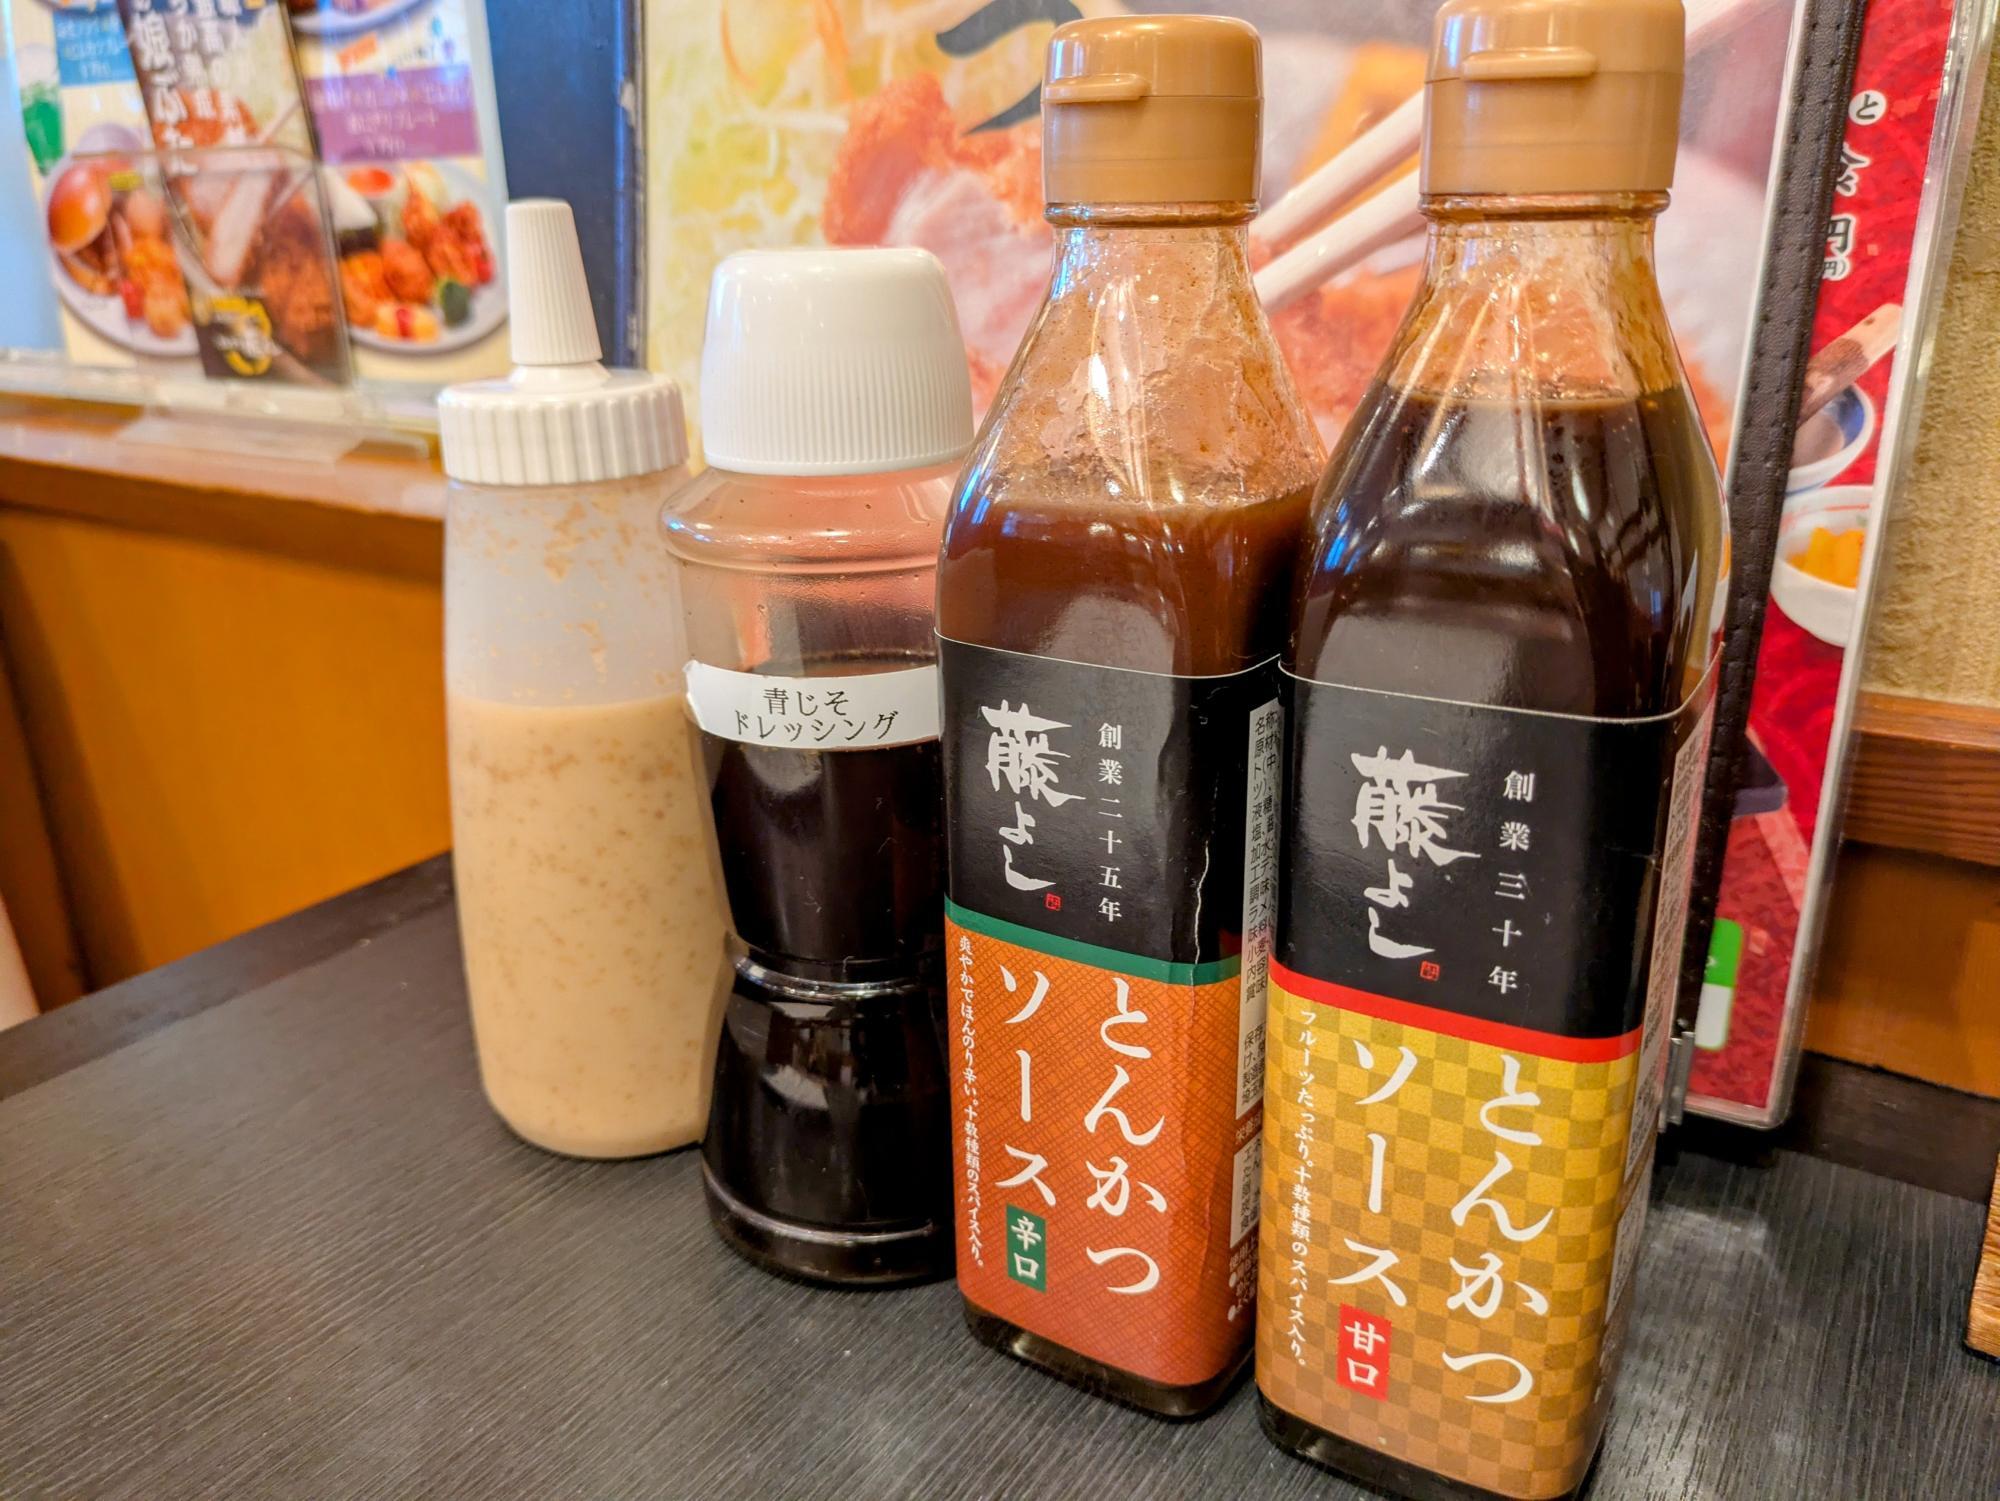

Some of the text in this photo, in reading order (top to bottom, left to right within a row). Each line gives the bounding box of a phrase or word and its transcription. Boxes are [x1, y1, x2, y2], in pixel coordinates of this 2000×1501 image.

[735, 709, 898, 742] ドレッシング
[763, 687, 849, 717] 青じそ
[979, 699, 1087, 891] 藤よし
[1098, 722, 1124, 922] 創業二十五年
[1350, 745, 1482, 959] 藤よし
[1487, 769, 1536, 996] 創業三十年
[994, 964, 1058, 1207] ソース
[1083, 976, 1169, 1295] とんかつ
[1286, 1009, 1318, 1369] フルーツたっぷり。十数種類のスパイス入り。
[1327, 1038, 1419, 1307] ソース
[1010, 1216, 1043, 1282] 辛口
[1441, 1053, 1556, 1405] とんかつ
[1344, 1320, 1387, 1388] 甘口
